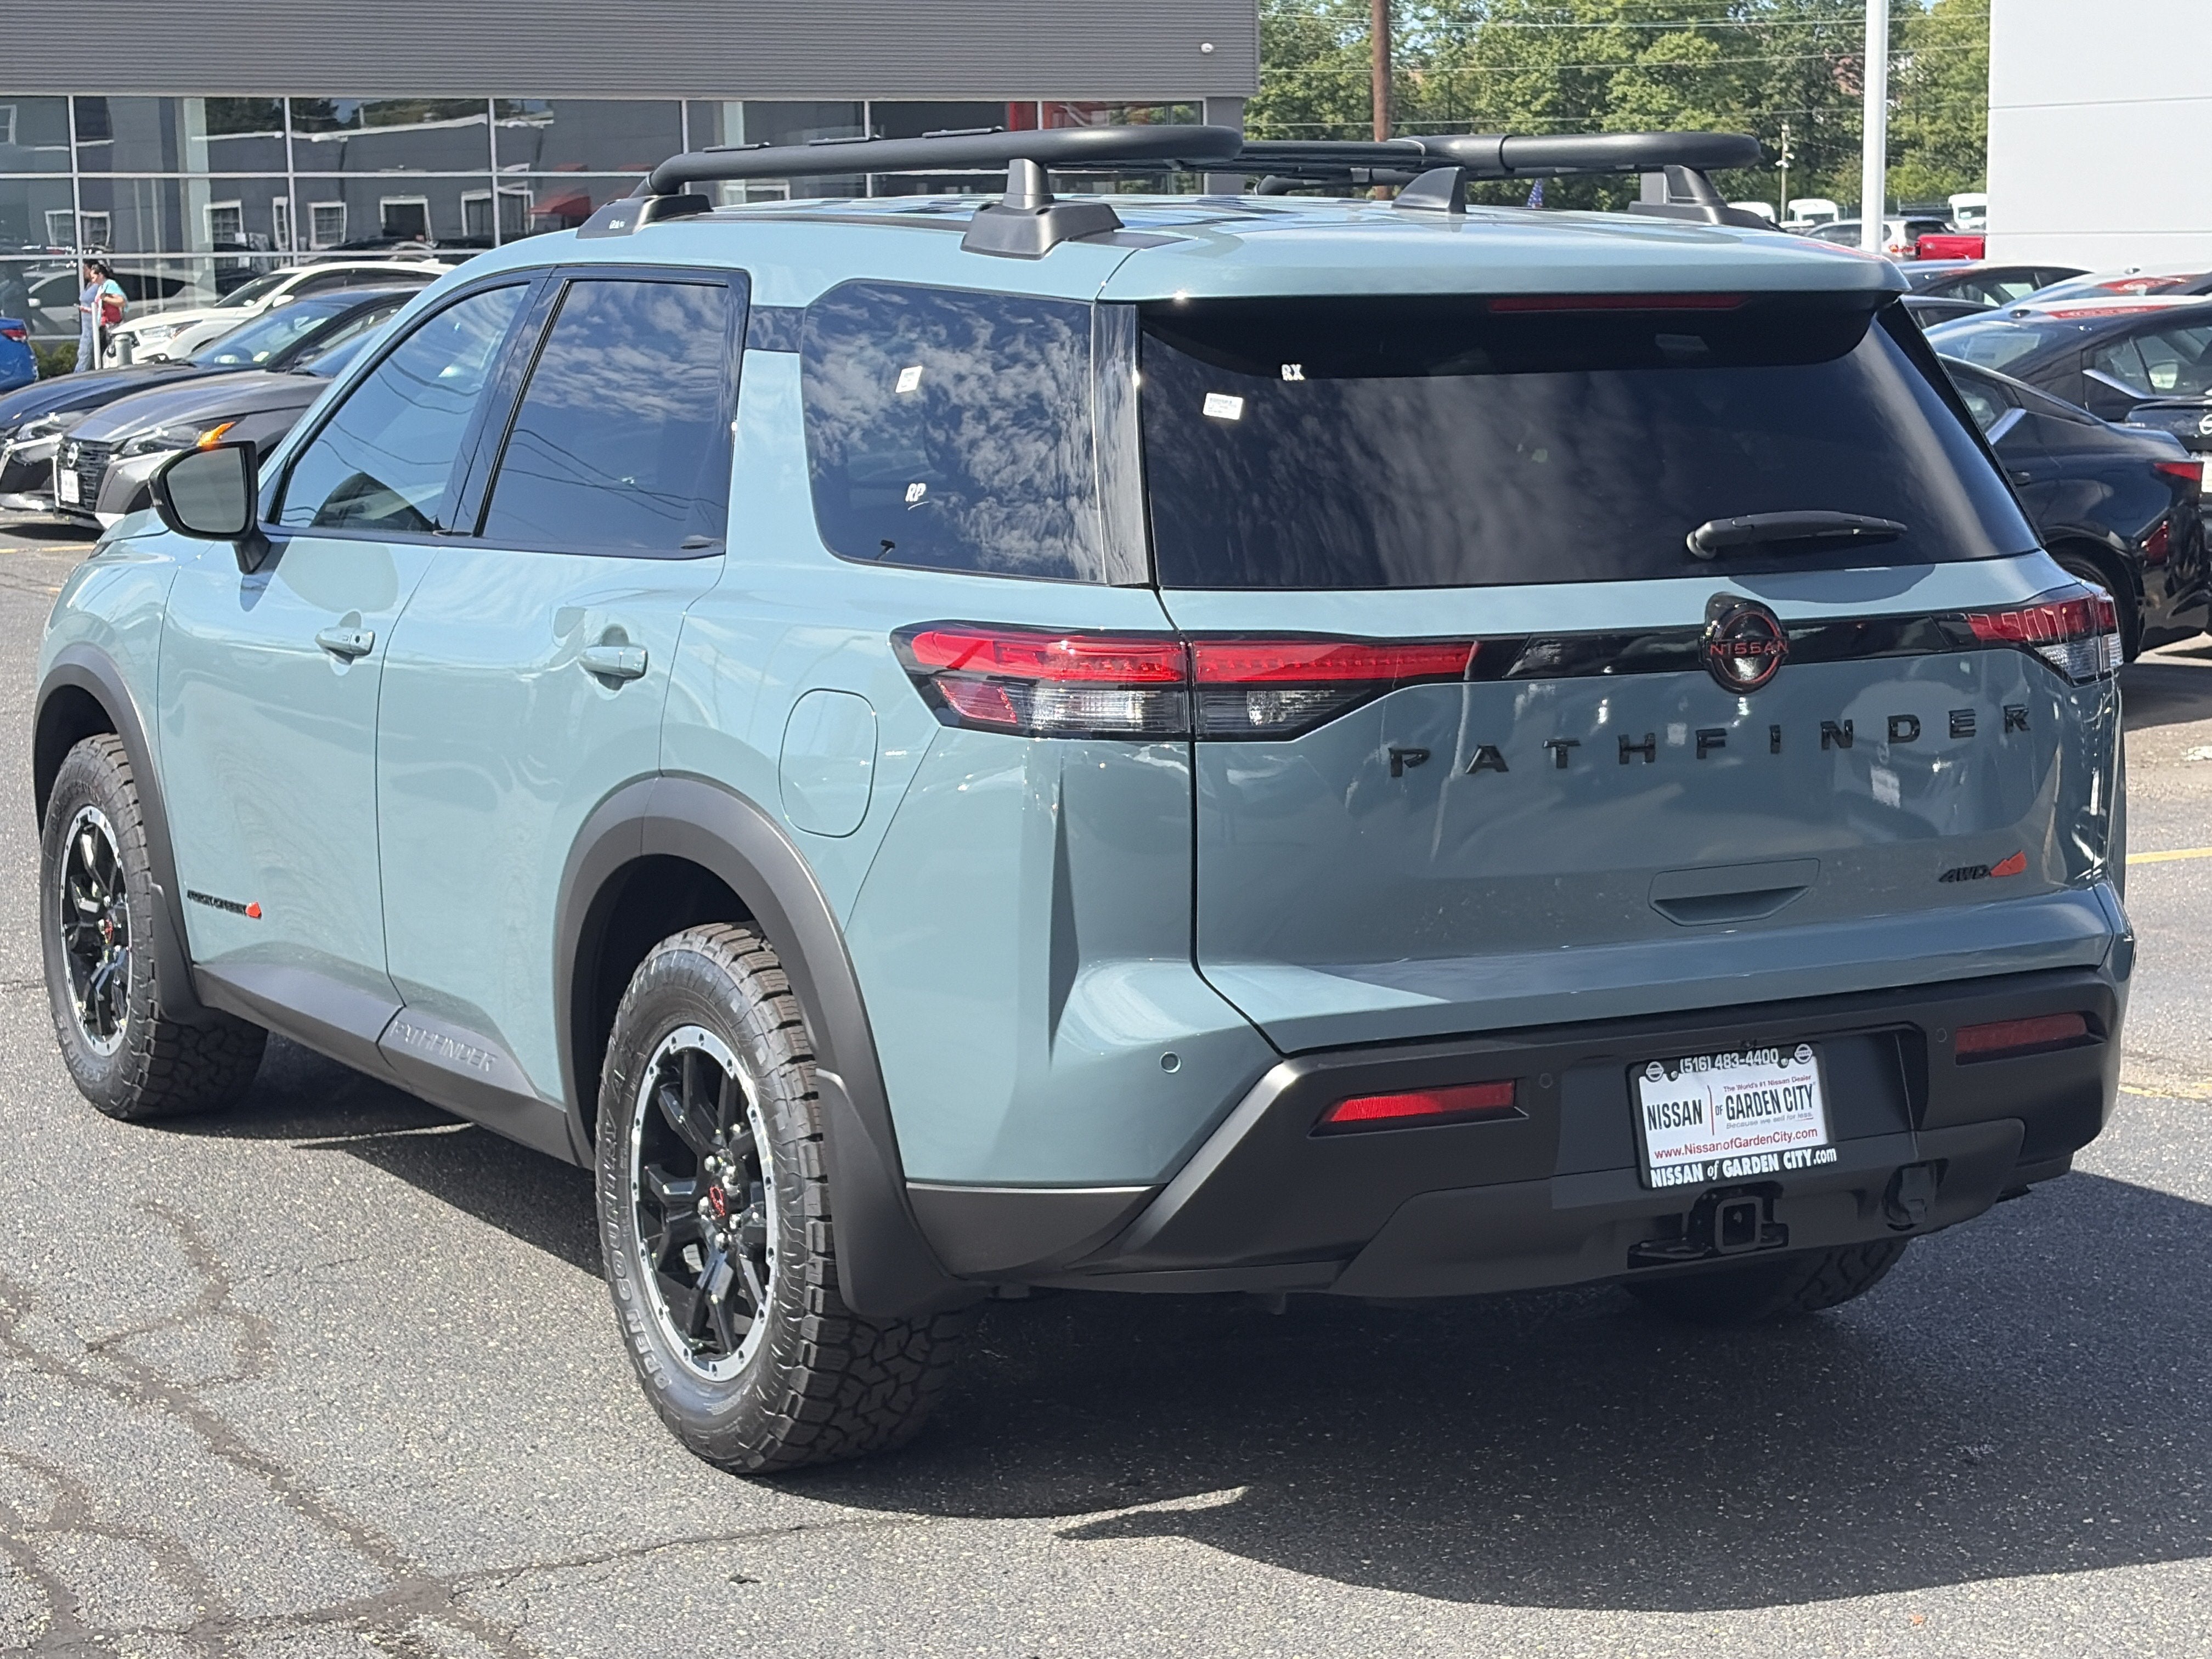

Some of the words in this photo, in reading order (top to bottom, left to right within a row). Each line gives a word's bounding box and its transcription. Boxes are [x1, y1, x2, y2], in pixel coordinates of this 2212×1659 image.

[1710, 640, 1788, 656] NISSAN
[1388, 703, 2030, 777] PATHFINDER
[1939, 865, 1989, 883] 4WD
[390, 1020, 498, 1071] PATHFINDER
[1679, 1056, 1711, 1074] (516)
[1714, 1048, 1779, 1069] 483-4400
[1791, 1075, 1812, 1083] Dealer
[1647, 1099, 1703, 1131] NISSAN
[1715, 1104, 1723, 1116] OF
[1725, 1088, 1781, 1121] GARDEN
[1783, 1084, 1813, 1112] CITY
[1726, 1120, 1759, 1130] Because
[1655, 1127, 1818, 1159] www.NissanofGardenCity.com
[1650, 1163, 1704, 1188] NISSAN
[1707, 1160, 1719, 1180] of
[1722, 1153, 1780, 1178] GARDEN
[1783, 1147, 1837, 1170] CITY.com
